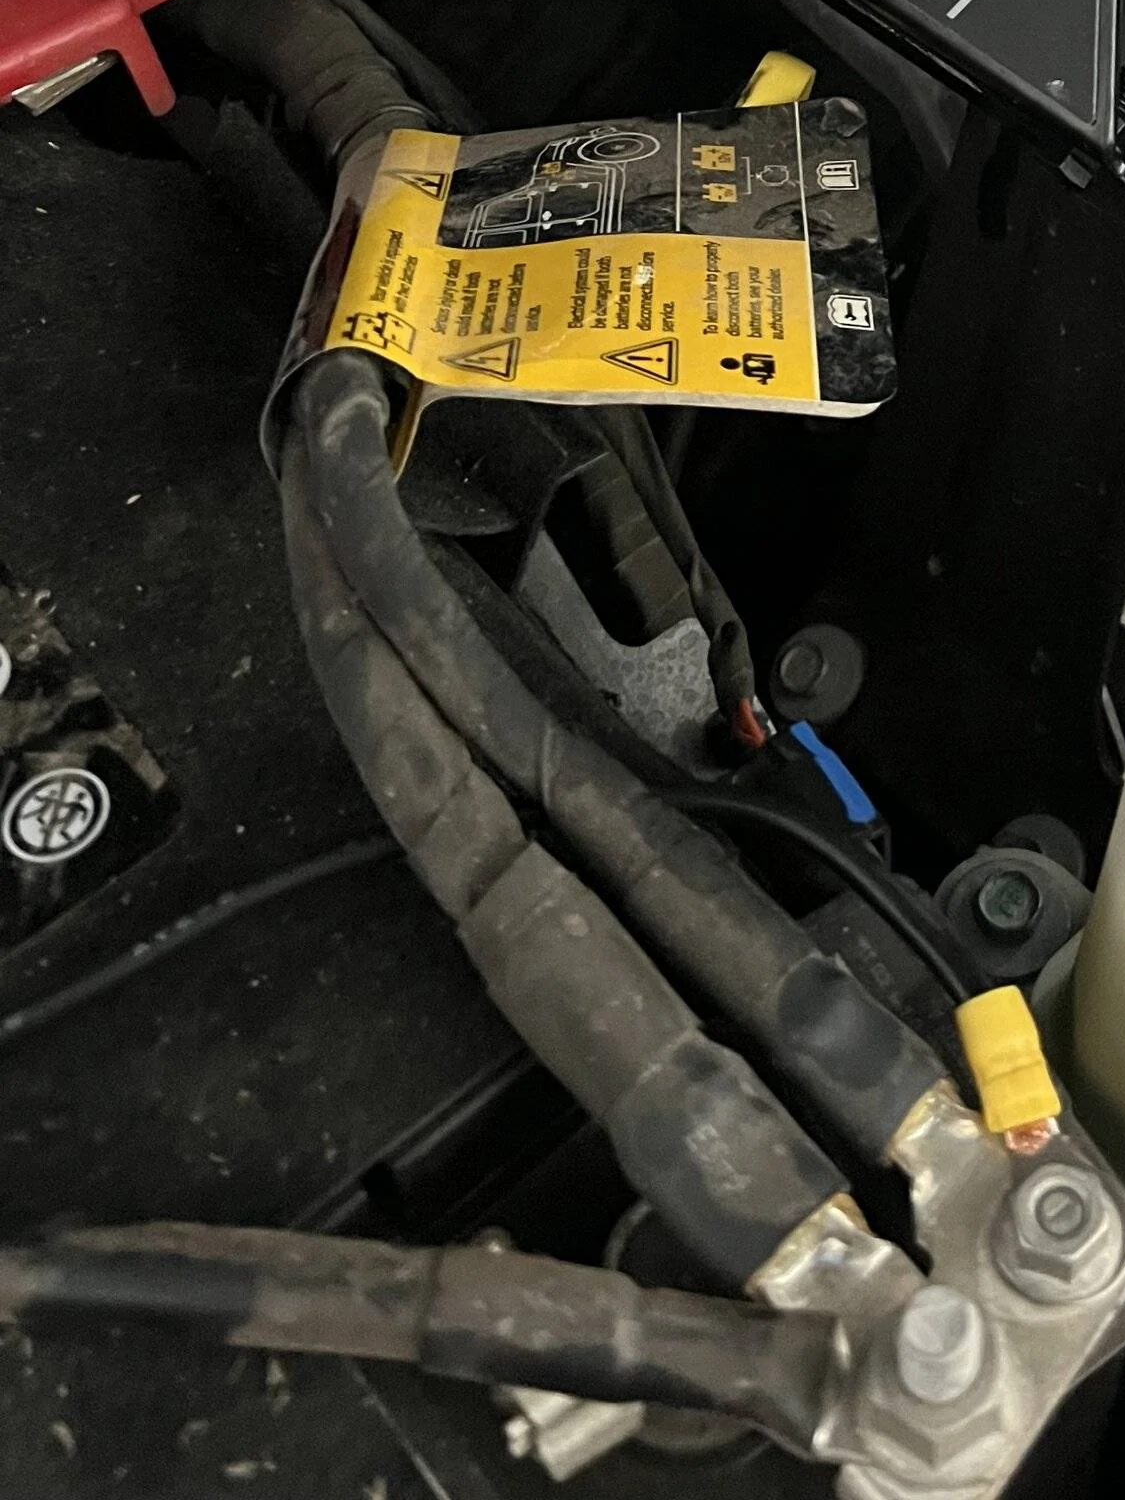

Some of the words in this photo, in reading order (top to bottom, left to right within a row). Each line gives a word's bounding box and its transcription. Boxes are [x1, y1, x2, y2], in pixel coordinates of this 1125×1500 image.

[574, 248, 591, 269] could
[596, 255, 612, 273] both
[702, 241, 722, 273] properly
[574, 269, 591, 295] system
[618, 265, 633, 280] not
[723, 271, 739, 290] both
[748, 265, 764, 285] your
[488, 278, 503, 292] not
[619, 281, 632, 293] are
[703, 282, 718, 301] how
[749, 284, 761, 298] see
[439, 286, 459, 308] injury
[487, 292, 500, 304] are
[590, 280, 613, 317] damaged
[430, 307, 450, 335] Serious
[567, 295, 587, 329] Electrical
[612, 294, 631, 329] batteries
[703, 302, 719, 323] learn
[725, 292, 740, 337] disconnect
[766, 294, 784, 340] authorized
[590, 317, 607, 329] be
[703, 325, 719, 335] To
